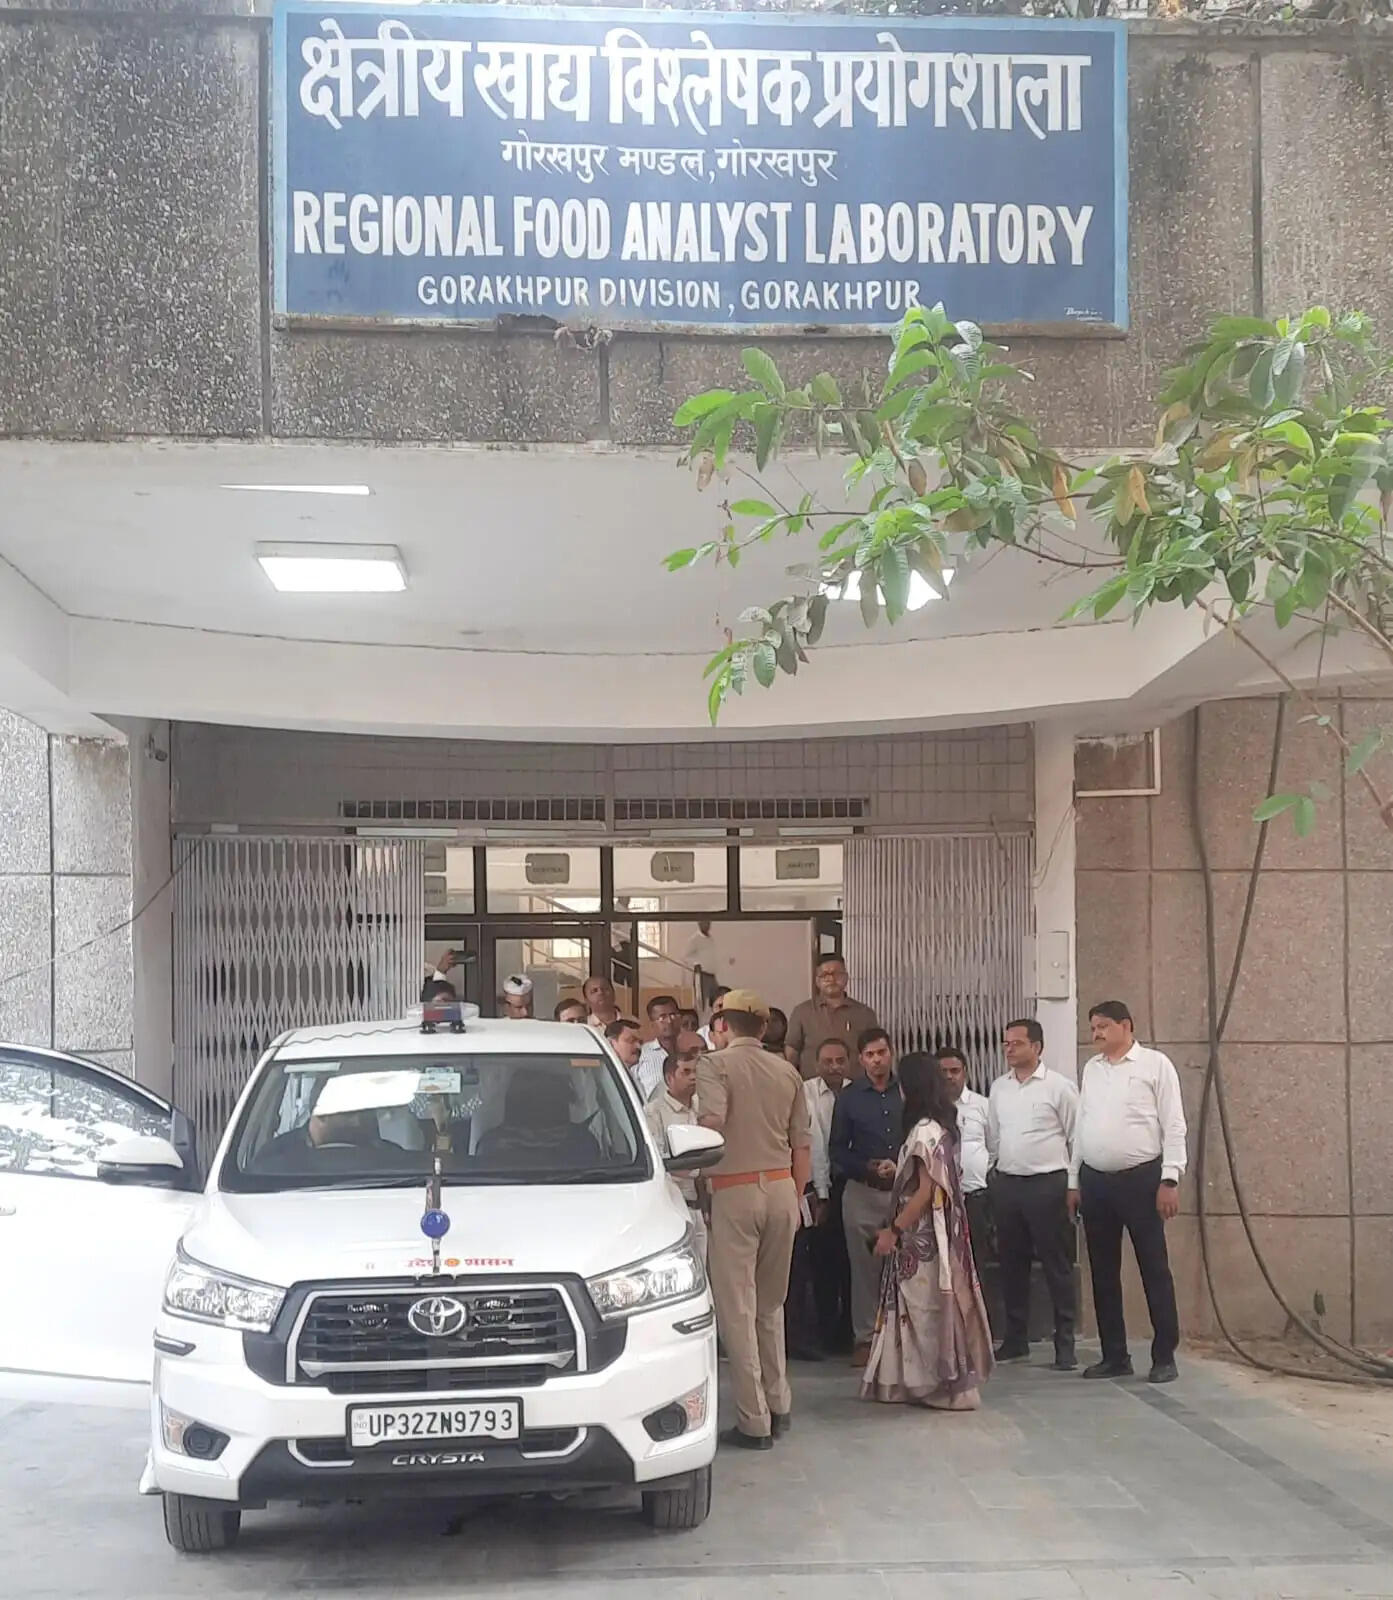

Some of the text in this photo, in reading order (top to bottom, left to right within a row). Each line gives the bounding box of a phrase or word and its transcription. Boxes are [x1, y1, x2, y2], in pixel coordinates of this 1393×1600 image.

[300, 18, 1092, 141] क्षेत्रीय खाद्य विश्लेषक प्रयोगशाला
[500, 129, 609, 183] गोरखपुर
[293, 190, 1094, 266] REGIONAL FOOD ANALYST LABORATORY
[417, 274, 590, 307] GORAKHPUR
[740, 279, 922, 311] GORAKHPUR
[369, 1409, 513, 1437] UP32ZN9793
[391, 1451, 485, 1466] CRYSTA
